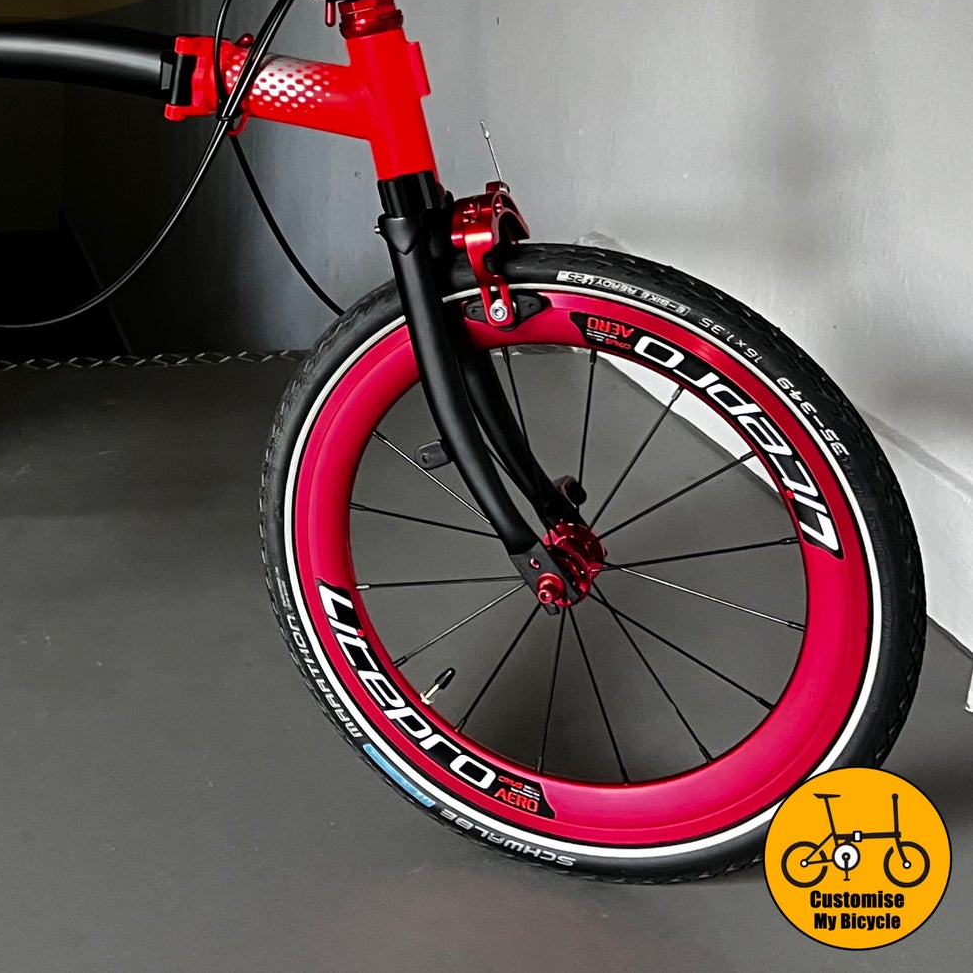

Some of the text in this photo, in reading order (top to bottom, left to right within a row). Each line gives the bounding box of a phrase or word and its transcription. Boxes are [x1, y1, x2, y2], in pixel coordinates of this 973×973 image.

[586, 316, 635, 338] AERO
[639, 291, 687, 315] E-BIKE
[633, 335, 840, 551] Litepro
[776, 377, 851, 456] 35-349
[286, 614, 363, 738] MARATHON
[318, 584, 497, 790] Litepro
[493, 788, 539, 813] AERO
[440, 808, 577, 867] SCHWALBE
